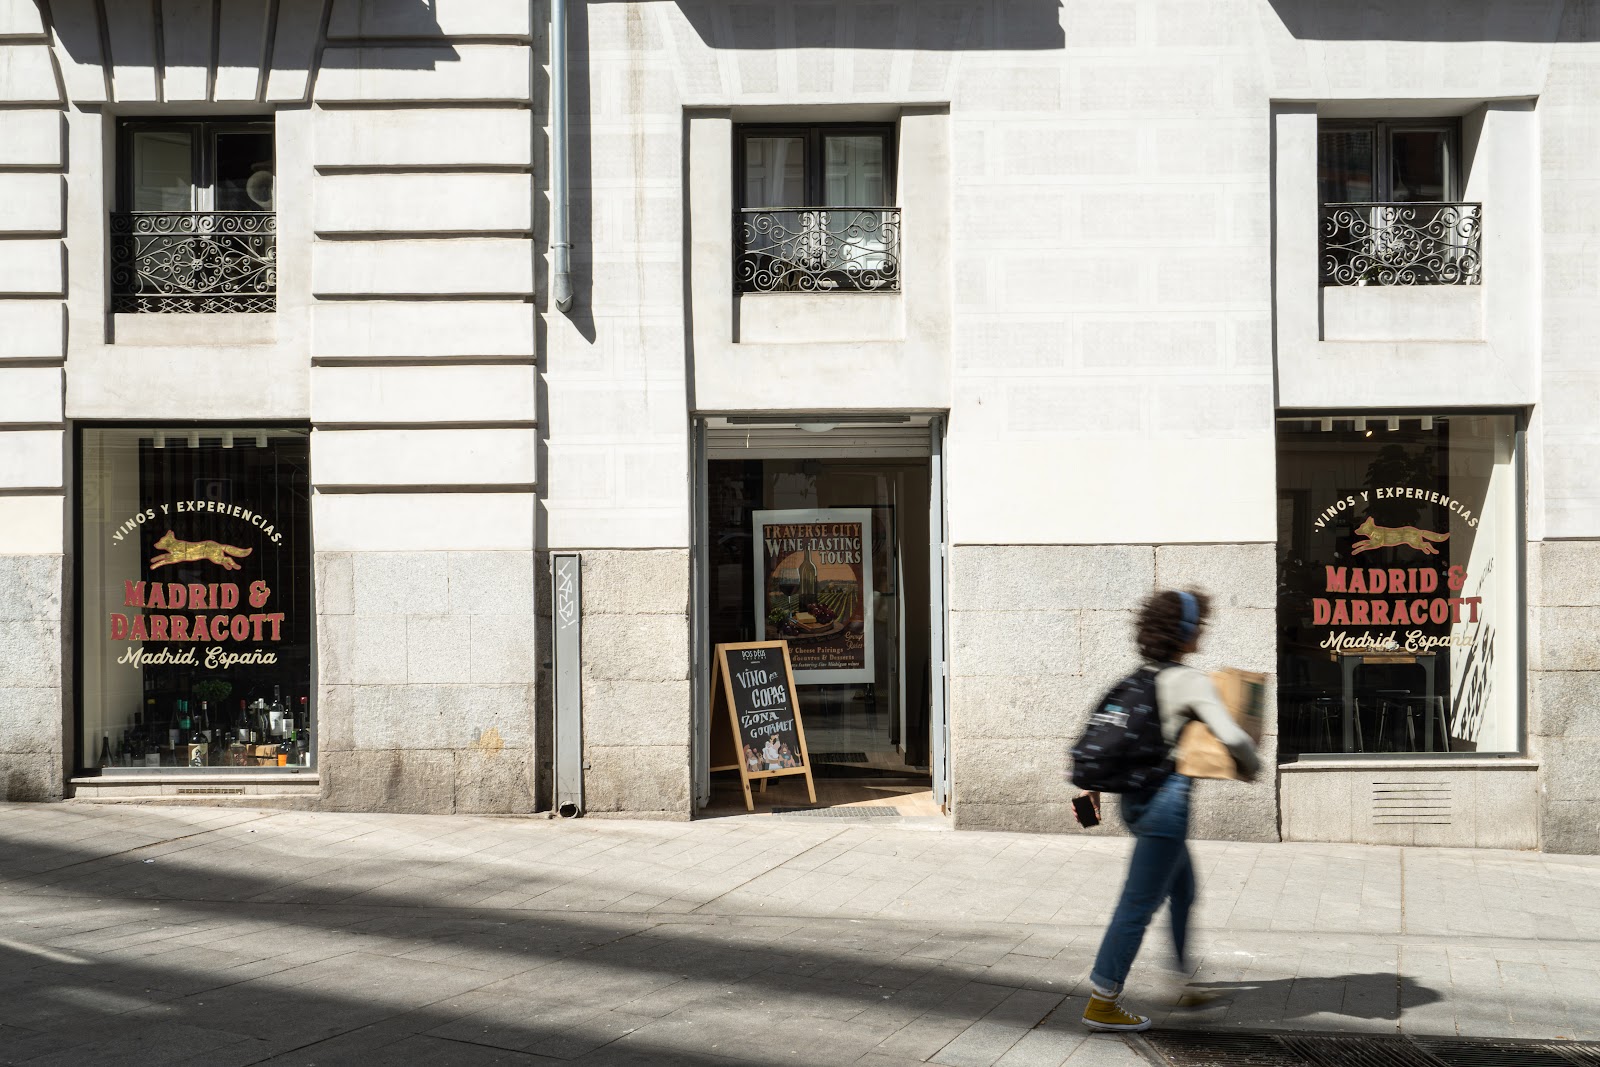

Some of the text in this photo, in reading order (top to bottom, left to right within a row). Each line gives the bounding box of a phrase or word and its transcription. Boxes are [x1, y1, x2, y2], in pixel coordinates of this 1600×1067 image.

[1314, 487, 1479, 529] VINOS Y EXPERIENCIAS
[112, 500, 283, 543] VINOS Y EXPERIENCIAS
[765, 524, 861, 539] TRAVERSE CITY
[765, 538, 861, 558] WINE TASTING
[820, 551, 861, 564] TOURS
[1325, 564, 1468, 594] MADRID &
[123, 579, 271, 610] MADRID &
[1312, 596, 1483, 626] DARRACOTT
[110, 612, 286, 642] DARRACOTT
[817, 646, 844, 654] Pairings
[1320, 629, 1474, 653] Madrid, España
[117, 646, 278, 670] Madrid, España
[741, 650, 753, 658] DOS
[751, 684, 787, 709] COPAS
[741, 711, 780, 729] ZONA
[750, 718, 794, 739] GOURMET
